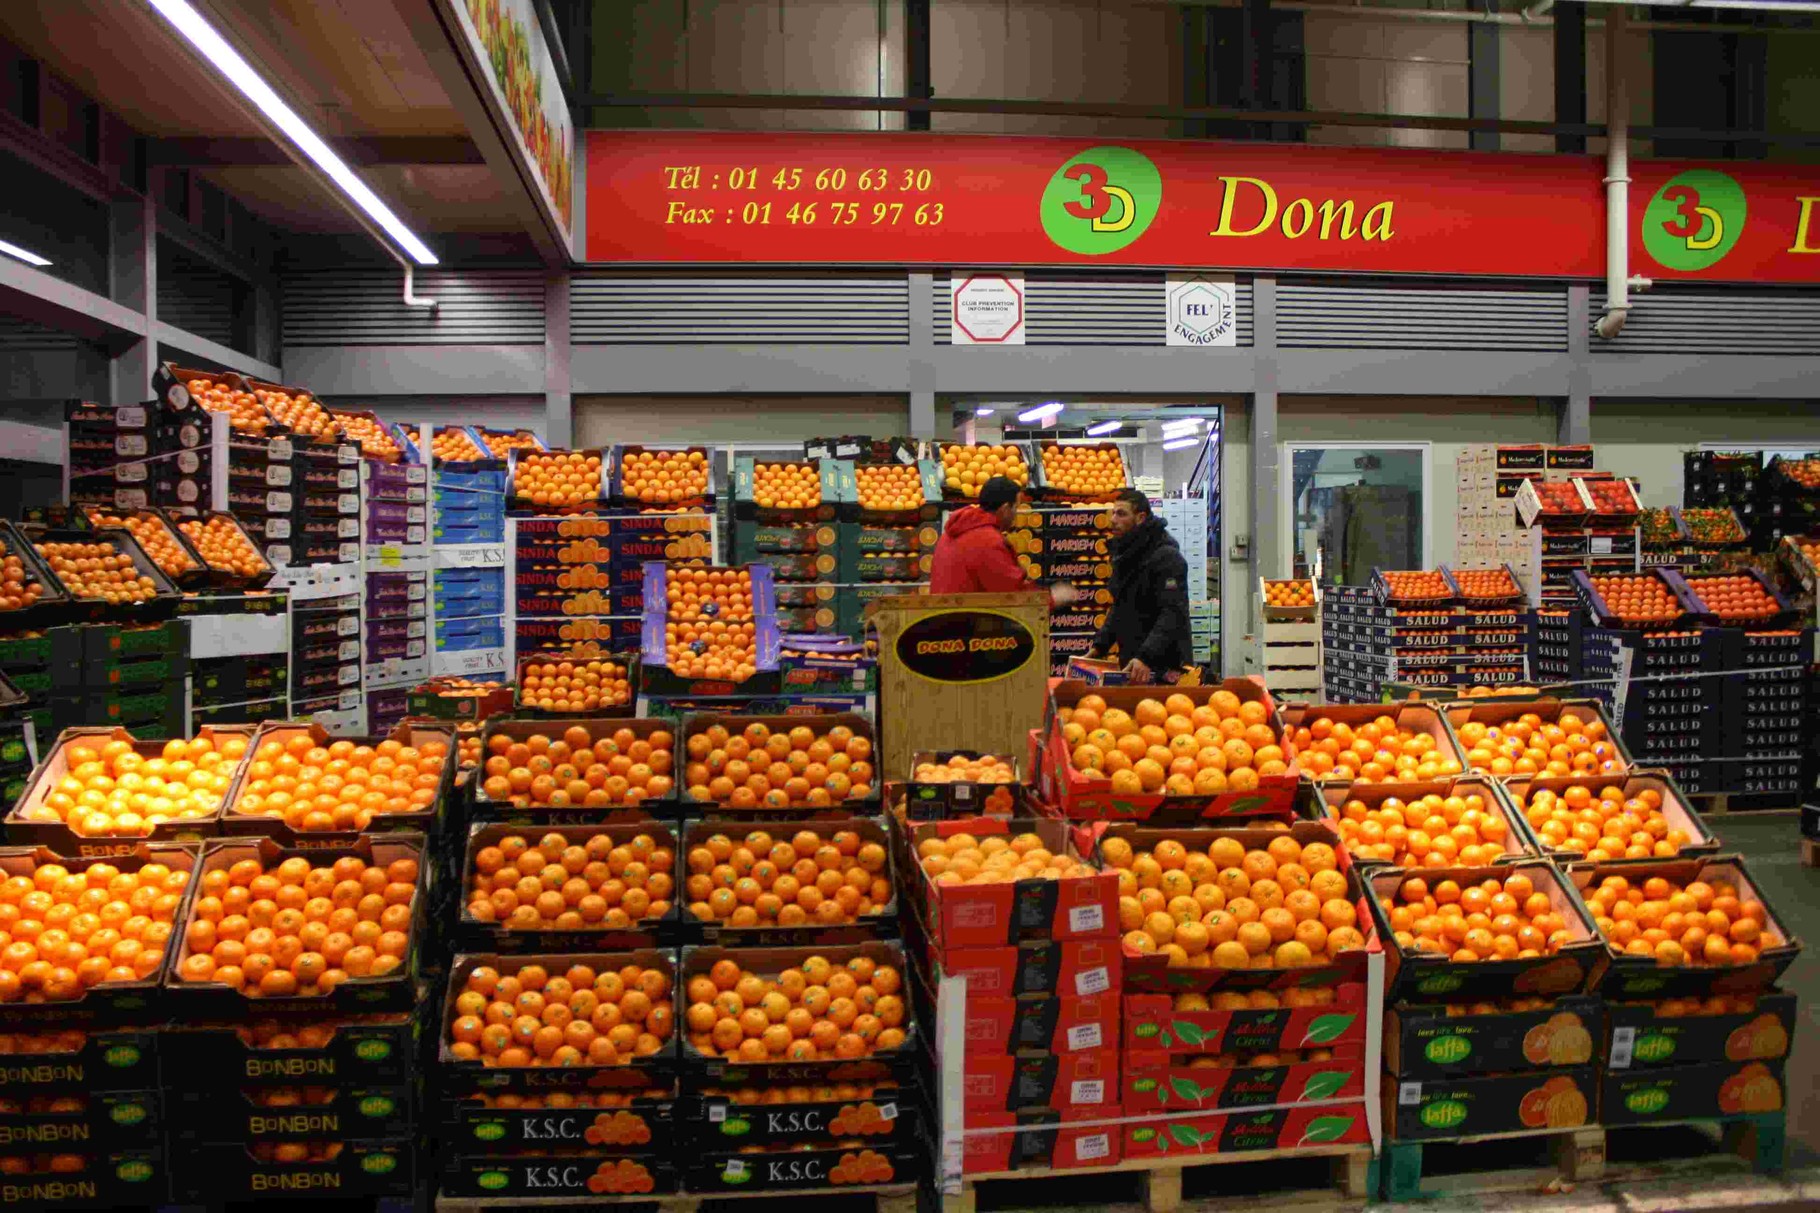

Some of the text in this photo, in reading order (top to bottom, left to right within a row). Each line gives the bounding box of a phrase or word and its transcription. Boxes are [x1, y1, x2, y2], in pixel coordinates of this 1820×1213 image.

[664, 166, 700, 190] Tél
[728, 168, 757, 190] 01
[772, 168, 802, 191] 45
[816, 168, 846, 191] 60
[858, 168, 887, 191] 63
[900, 168, 932, 192] 30
[664, 202, 714, 225] Fax
[742, 202, 771, 225] 01
[786, 202, 816, 225] 46
[830, 202, 860, 225] 75
[870, 202, 904, 226] 97
[914, 203, 944, 226] 63
[1210, 176, 1396, 242] Dona
[1174, 304, 1232, 344] ENGAGEMENT
[622, 543, 663, 554] SINDA
[518, 600, 559, 611] SINDA
[1406, 616, 1449, 626] SALUD
[1474, 614, 1517, 624] SALUD
[1538, 616, 1569, 625] SALUD
[1406, 636, 1448, 645] SALUD
[1474, 634, 1516, 644] SALUD
[1538, 631, 1569, 641] SALUD
[1749, 636, 1800, 646] SALUD
[917, 637, 1018, 654] DONA DONA
[1648, 637, 1700, 647] SALUD
[1538, 646, 1569, 657] SALUD
[1646, 654, 1700, 665] SALUD
[1746, 653, 1798, 663] SALUD
[1538, 662, 1569, 673] SALUD
[1406, 674, 1448, 684] SALUD
[1474, 672, 1516, 682] SALUD
[1648, 688, 1701, 698] SALUD
[1747, 686, 1799, 696] SALUD
[1648, 704, 1701, 715] SALUD
[1748, 701, 1800, 712] SALUD
[1647, 721, 1700, 732] SALUD
[1747, 717, 1799, 729] SALUD
[1646, 738, 1700, 749] SALUD
[1745, 733, 1798, 745] SALUD
[1745, 765, 1798, 777] SALUD
[1745, 780, 1798, 792] SALUD
[768, 1112, 824, 1133] K.S.C.
[522, 1118, 580, 1139] K.S.C.
[768, 1160, 826, 1182] K.S.C.
[525, 1167, 584, 1188] K.S.C.
